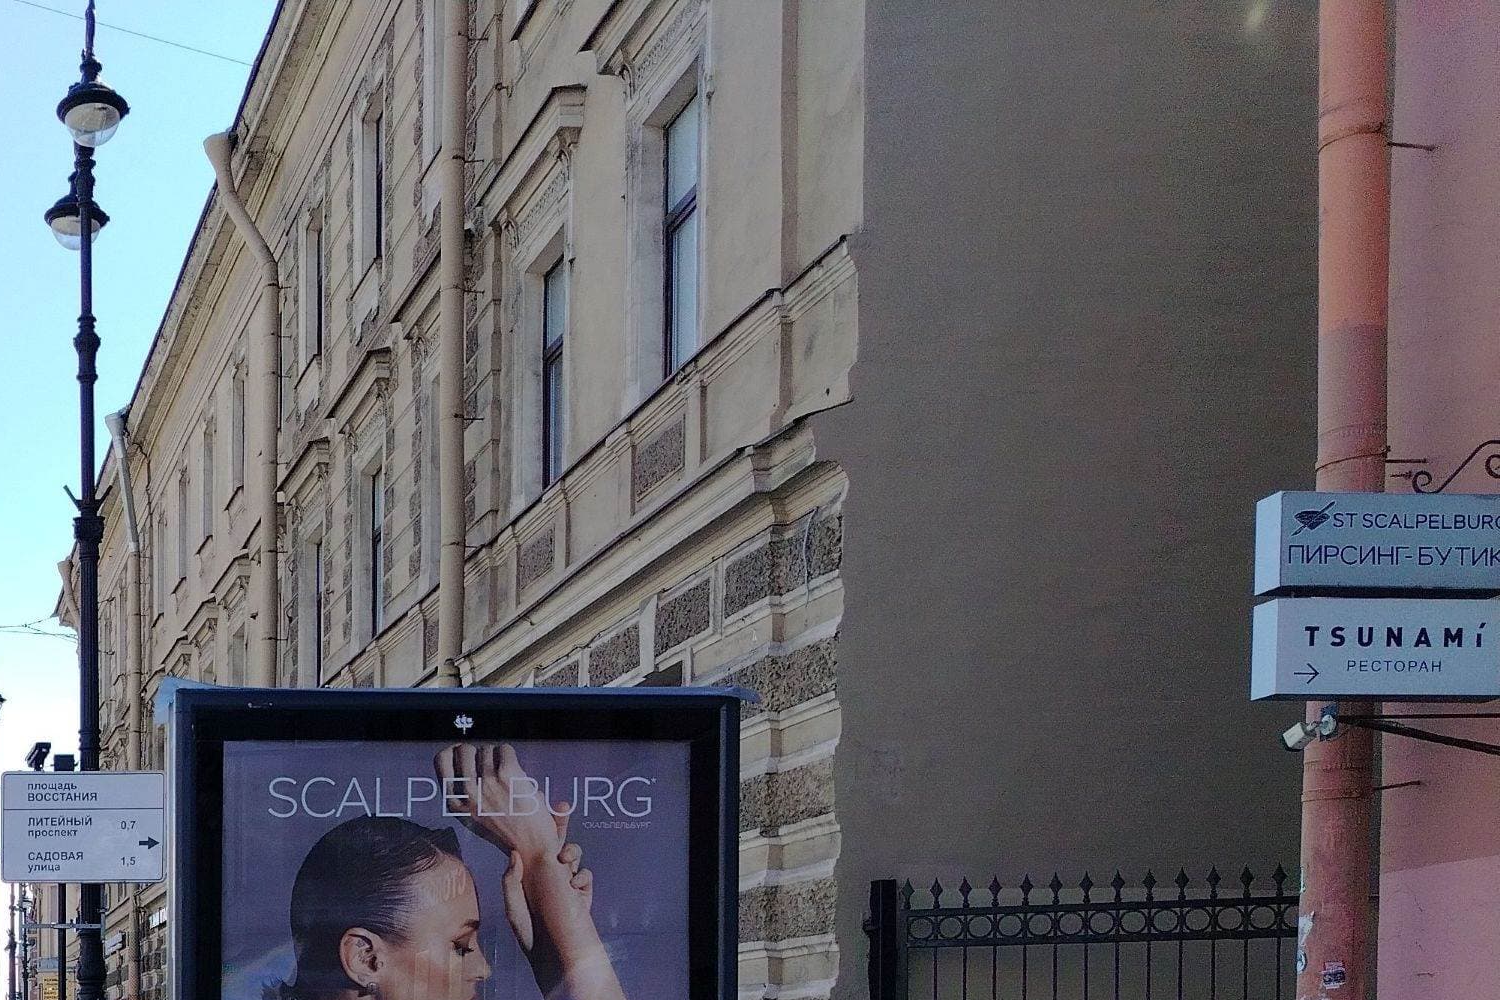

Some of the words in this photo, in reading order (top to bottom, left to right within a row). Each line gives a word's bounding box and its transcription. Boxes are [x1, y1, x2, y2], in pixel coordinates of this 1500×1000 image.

[1333, 512, 1358, 528] ST
[1346, 659, 1442, 673] РЕСТОРАН
[27, 782, 78, 791] площадь
[27, 792, 98, 802] ВОССТАНИЯ
[27, 815, 93, 827] ЛИТЕЙНЫЙ
[120, 820, 136, 831] 0,7
[27, 829, 78, 839] проспект
[27, 851, 84, 862] САДОВАЯ
[120, 857, 136, 867] 1,5
[27, 863, 61, 873] улица
